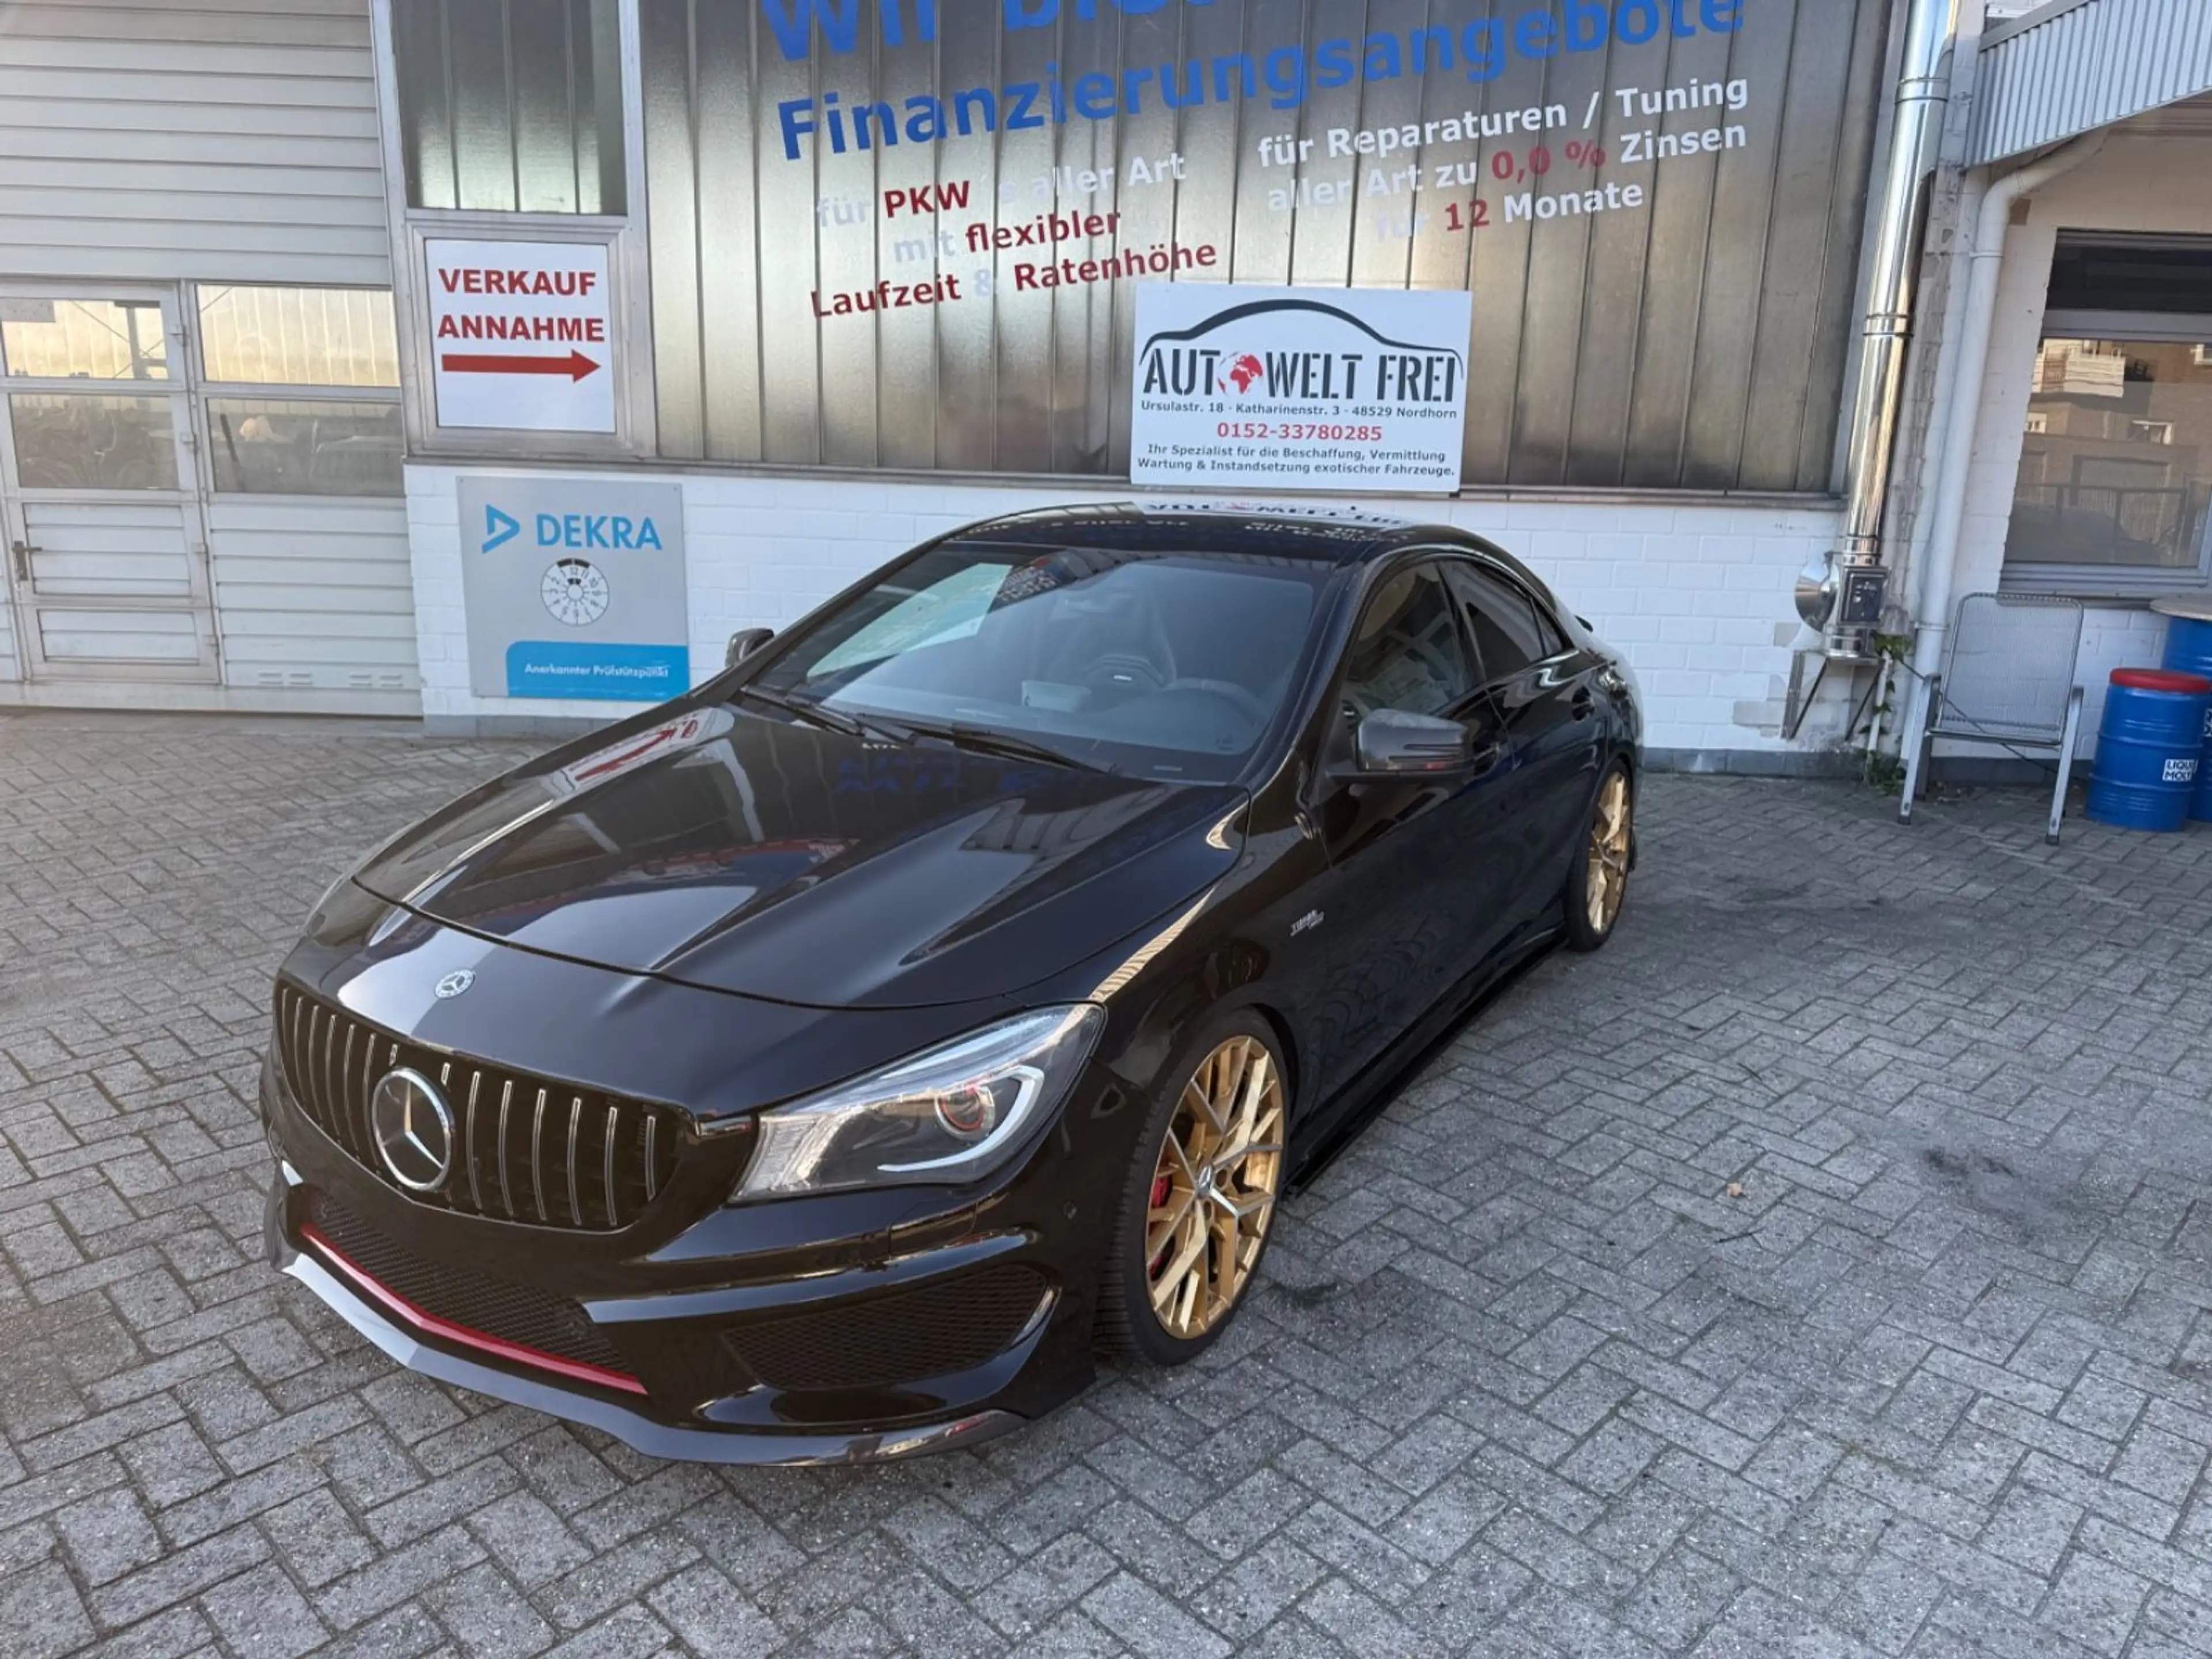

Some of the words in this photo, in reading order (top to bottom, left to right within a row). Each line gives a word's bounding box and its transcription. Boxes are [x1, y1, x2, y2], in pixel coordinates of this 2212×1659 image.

[778, 0, 1744, 161] Finanzierungsangebote
[1257, 134, 1313, 167] für
[1327, 104, 1566, 158] Reparaturen
[1582, 92, 1599, 129] /
[1616, 78, 1748, 117] Tuning
[1030, 165, 1115, 199] aller
[1128, 153, 1185, 187] Art
[1268, 178, 1351, 211] aller
[1366, 164, 1423, 197] Art
[1435, 162, 1477, 188] zu
[1491, 146, 1551, 183] 0,0
[1565, 140, 1606, 169] %
[1620, 123, 1746, 163] Zinsen
[1445, 199, 1490, 230] 12
[1503, 181, 1643, 222] Monate
[894, 231, 955, 263] mit
[966, 210, 1120, 252] flexibler
[438, 268, 596, 296] VERKAUF
[811, 274, 961, 318] Laufzeit
[1014, 243, 1217, 290] Ratenhöhe
[437, 315, 605, 342] ANNAHME
[1377, 355, 1456, 402] FREI
[1141, 401, 1204, 412] Ursulastr.
[1209, 402, 1224, 412] 18
[1236, 404, 1327, 416] Katharinenstr.
[1332, 406, 1340, 415] 3
[1351, 406, 1392, 416] 48529
[1396, 407, 1457, 419] Nordhorn
[1217, 422, 1382, 441] 0152-33780285
[1138, 458, 1192, 471] Wartung
[1197, 460, 1206, 469] &
[1210, 460, 1310, 474] Instandsetzung
[1314, 464, 1380, 474] exotischer
[1385, 464, 1455, 477] Fahrzeuge.
[1147, 444, 1167, 454] Ihr
[1171, 445, 1233, 458] Spezialist
[1237, 446, 1256, 457] für
[1259, 448, 1278, 457] die
[1283, 448, 1365, 461] Beschaffung,
[1369, 450, 1445, 463] Vermittlung
[536, 513, 662, 551] DEKRA
